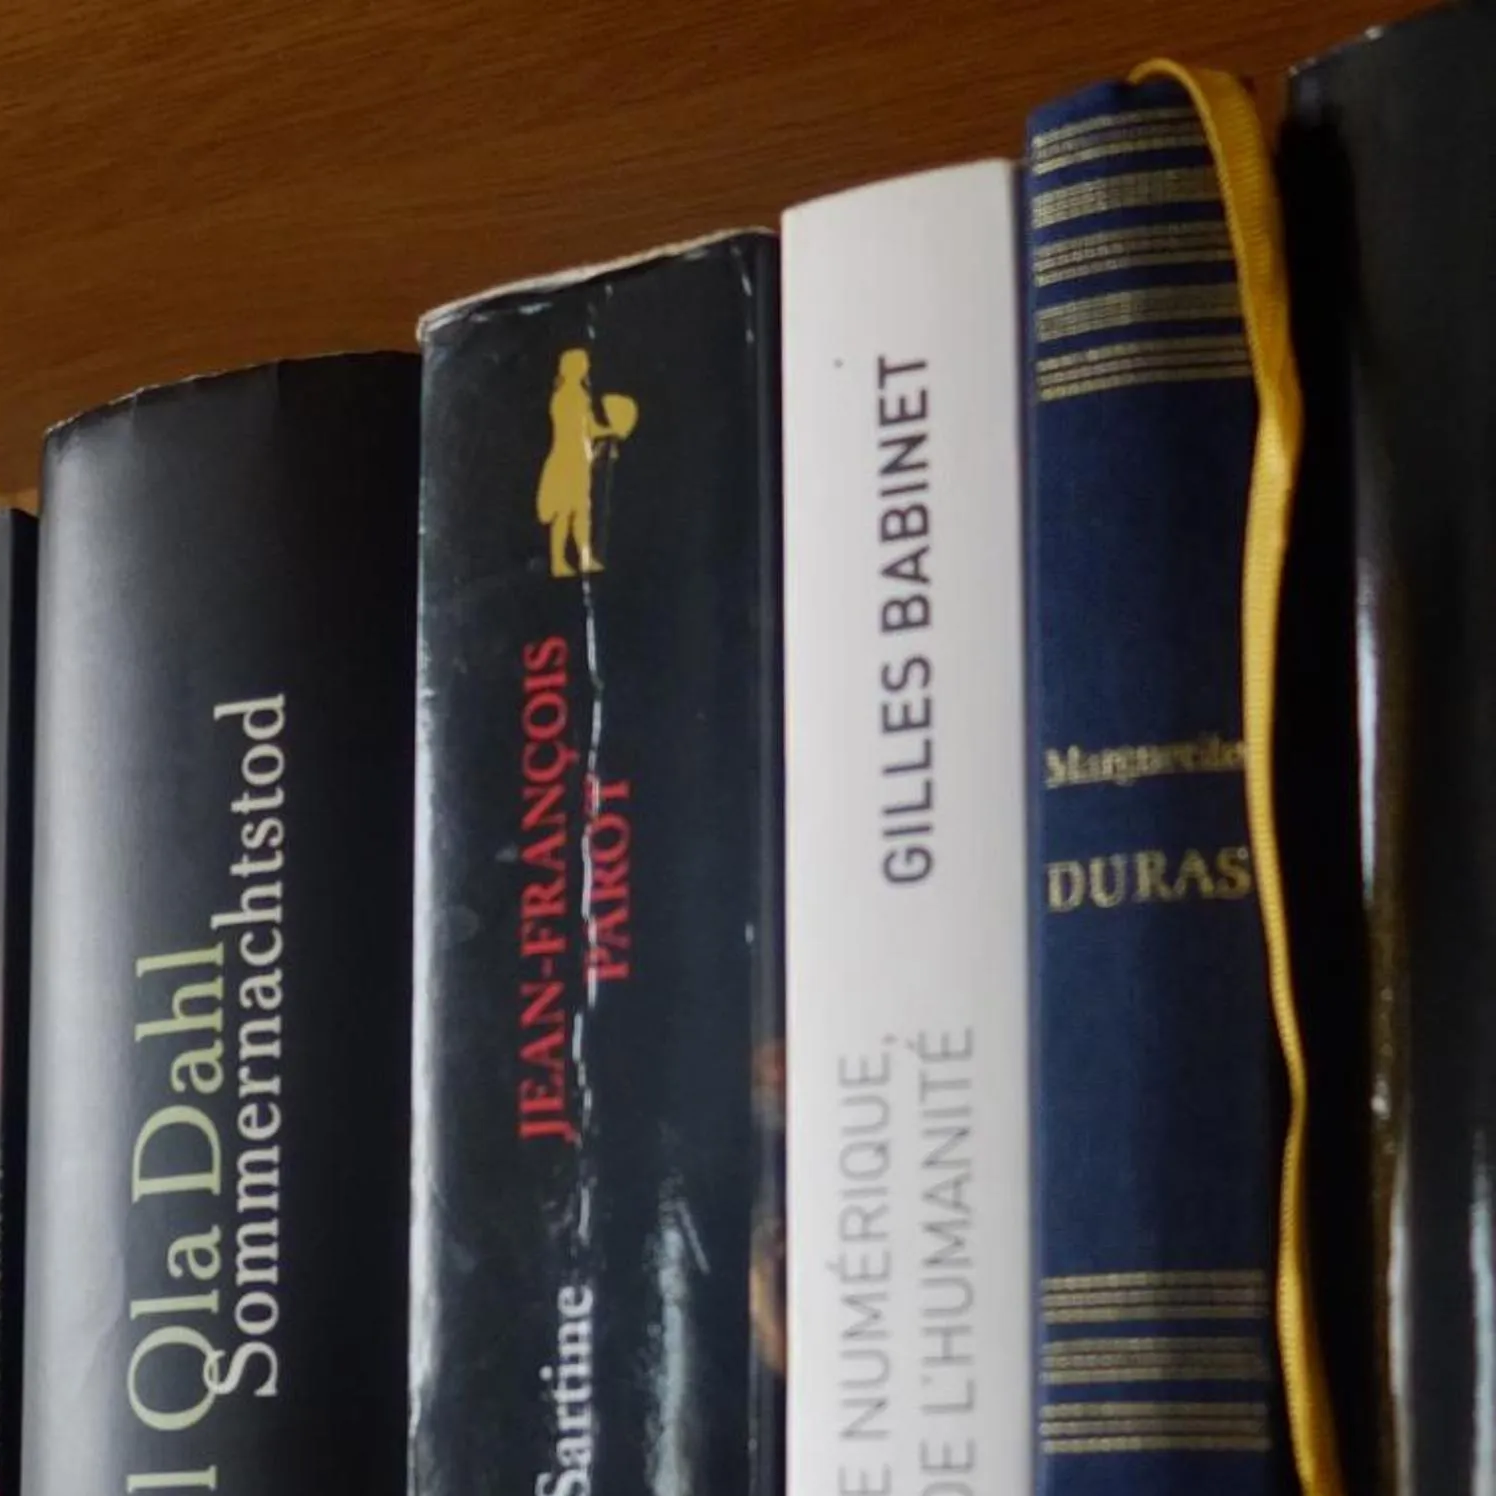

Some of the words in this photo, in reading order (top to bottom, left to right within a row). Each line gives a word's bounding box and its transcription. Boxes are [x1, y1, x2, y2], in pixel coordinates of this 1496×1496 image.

[878, 354, 933, 634] BABINET
[517, 635, 580, 1144] JEAN-FRANÇOIS
[584, 773, 632, 981] PAROT
[880, 654, 935, 887] GILLES
[1047, 846, 1253, 913] DURAS
[131, 943, 224, 1203] Dahl
[204, 694, 286, 1397] Sommernachtstod
[127, 1224, 221, 1431] Ola
[824, 1032, 898, 1441] NUMÉRIQUE,
[904, 1026, 975, 1416] L'HUMANITÉ
